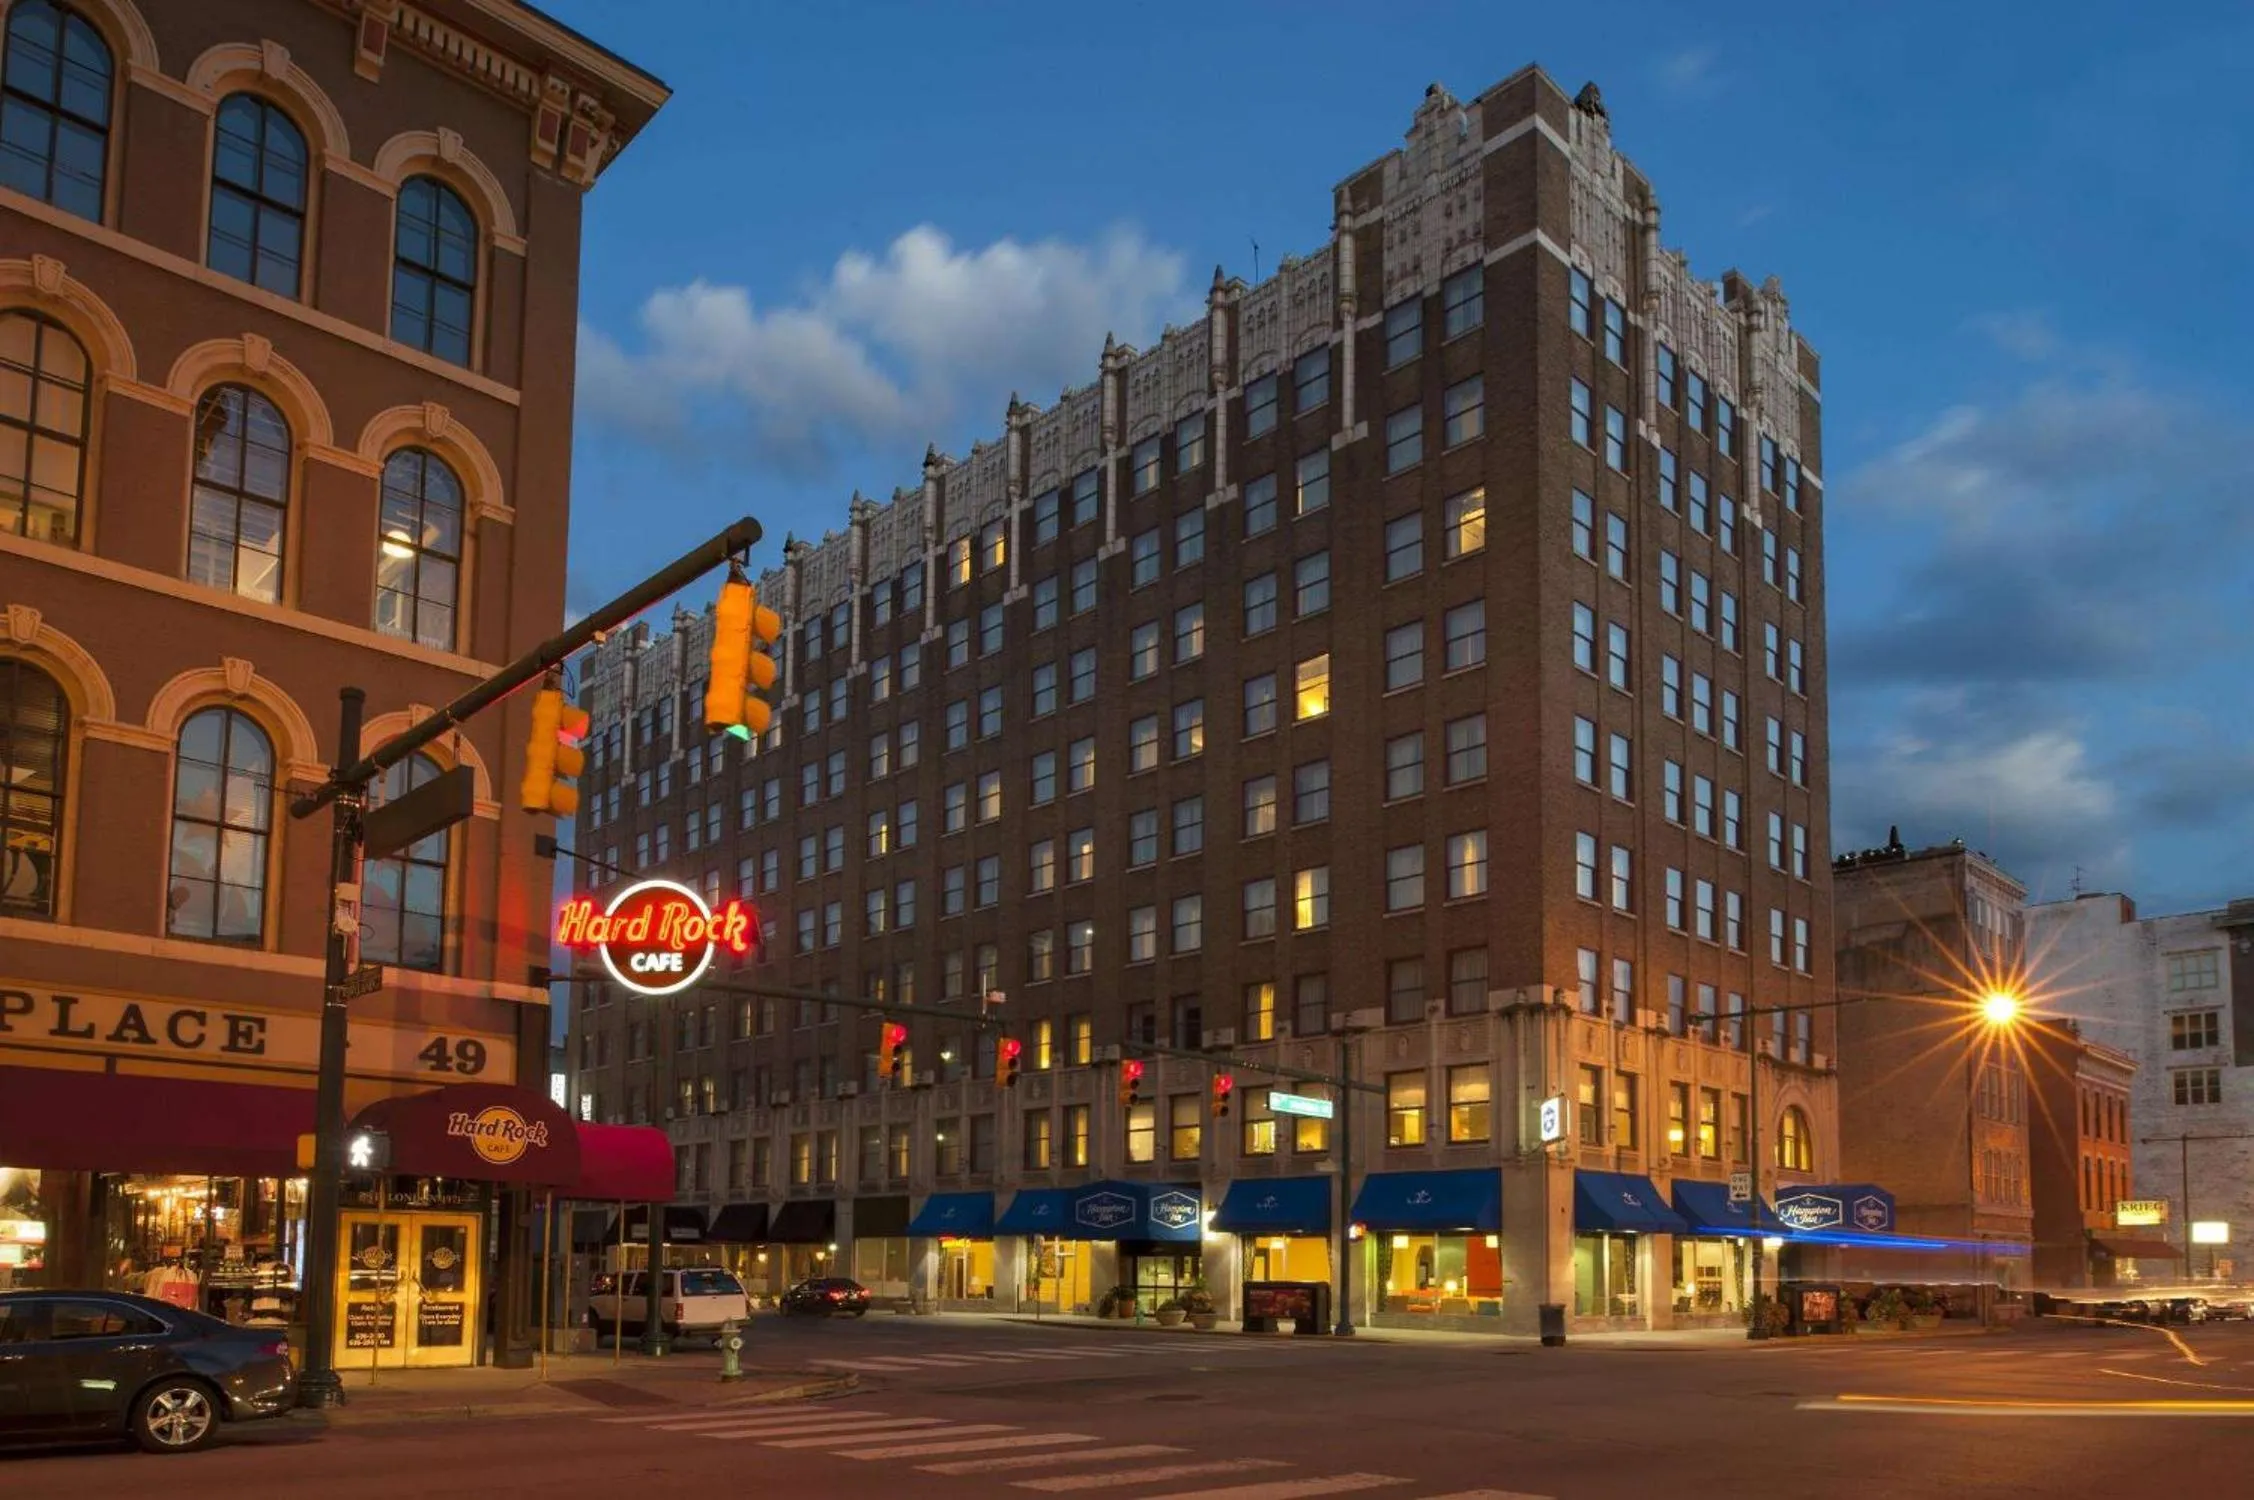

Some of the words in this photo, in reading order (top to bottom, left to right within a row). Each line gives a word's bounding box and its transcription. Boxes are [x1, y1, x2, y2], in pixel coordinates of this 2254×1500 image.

[559, 900, 654, 944] Hard
[658, 900, 748, 951] Rock
[630, 952, 684, 973] CAFE
[0, 990, 267, 1055] PLACE
[418, 1036, 487, 1075] 49
[448, 1112, 500, 1137] Hard
[502, 1119, 548, 1147] Rock
[1782, 1205, 1837, 1217] Hampton
[2121, 1203, 2163, 1211] KRIEG
